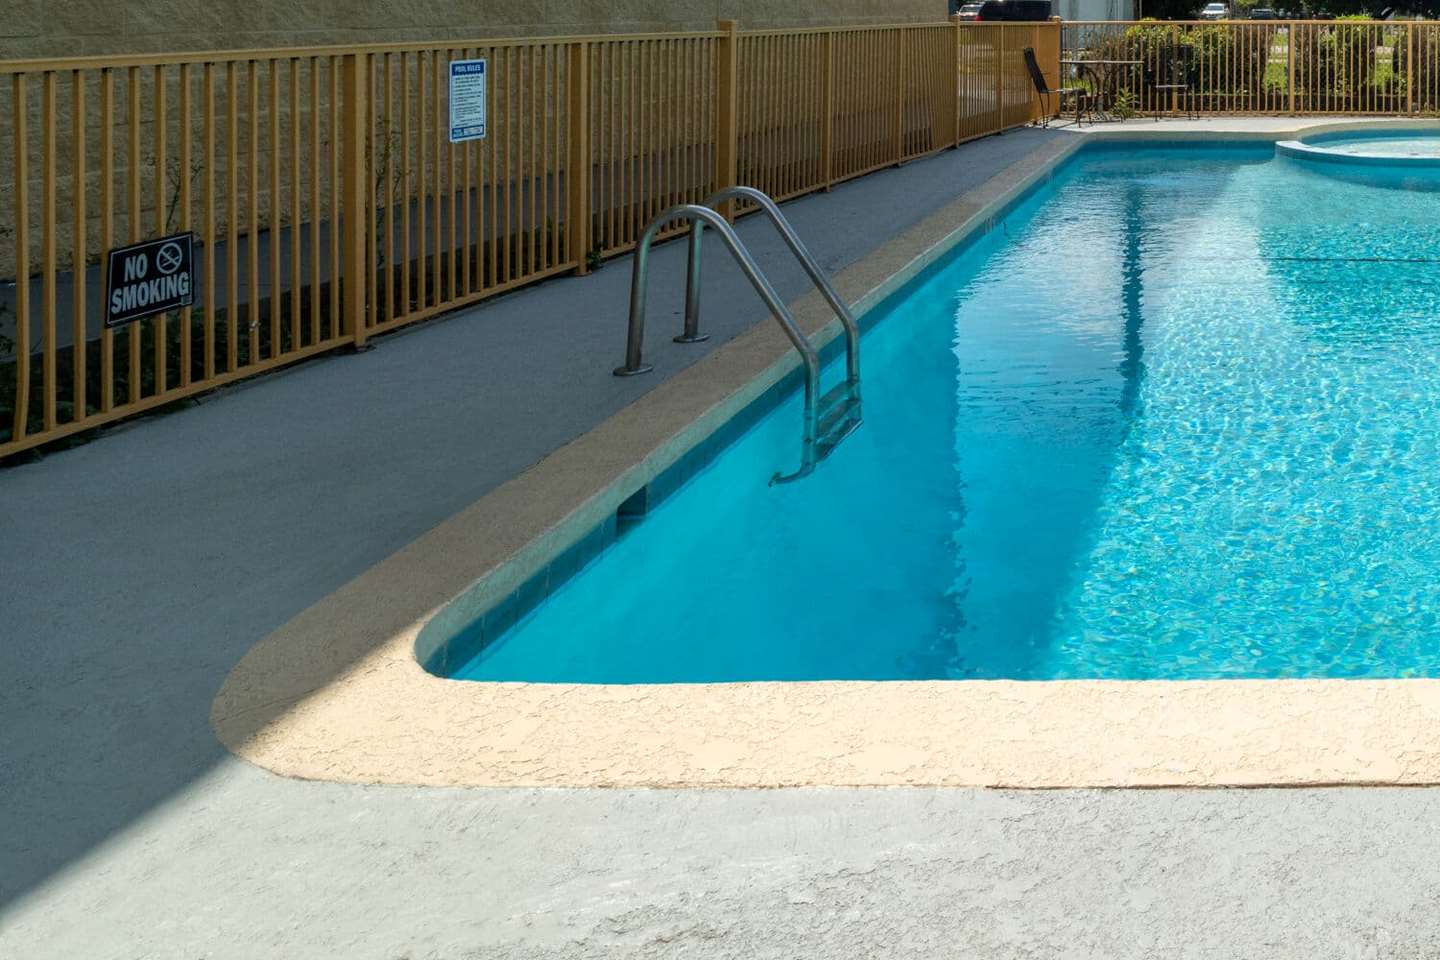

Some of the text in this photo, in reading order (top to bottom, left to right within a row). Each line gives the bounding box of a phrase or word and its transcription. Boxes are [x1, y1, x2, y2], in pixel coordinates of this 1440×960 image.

[454, 64, 481, 73] POOL RULES
[124, 253, 148, 282] NO
[111, 271, 189, 315] SMOKING
